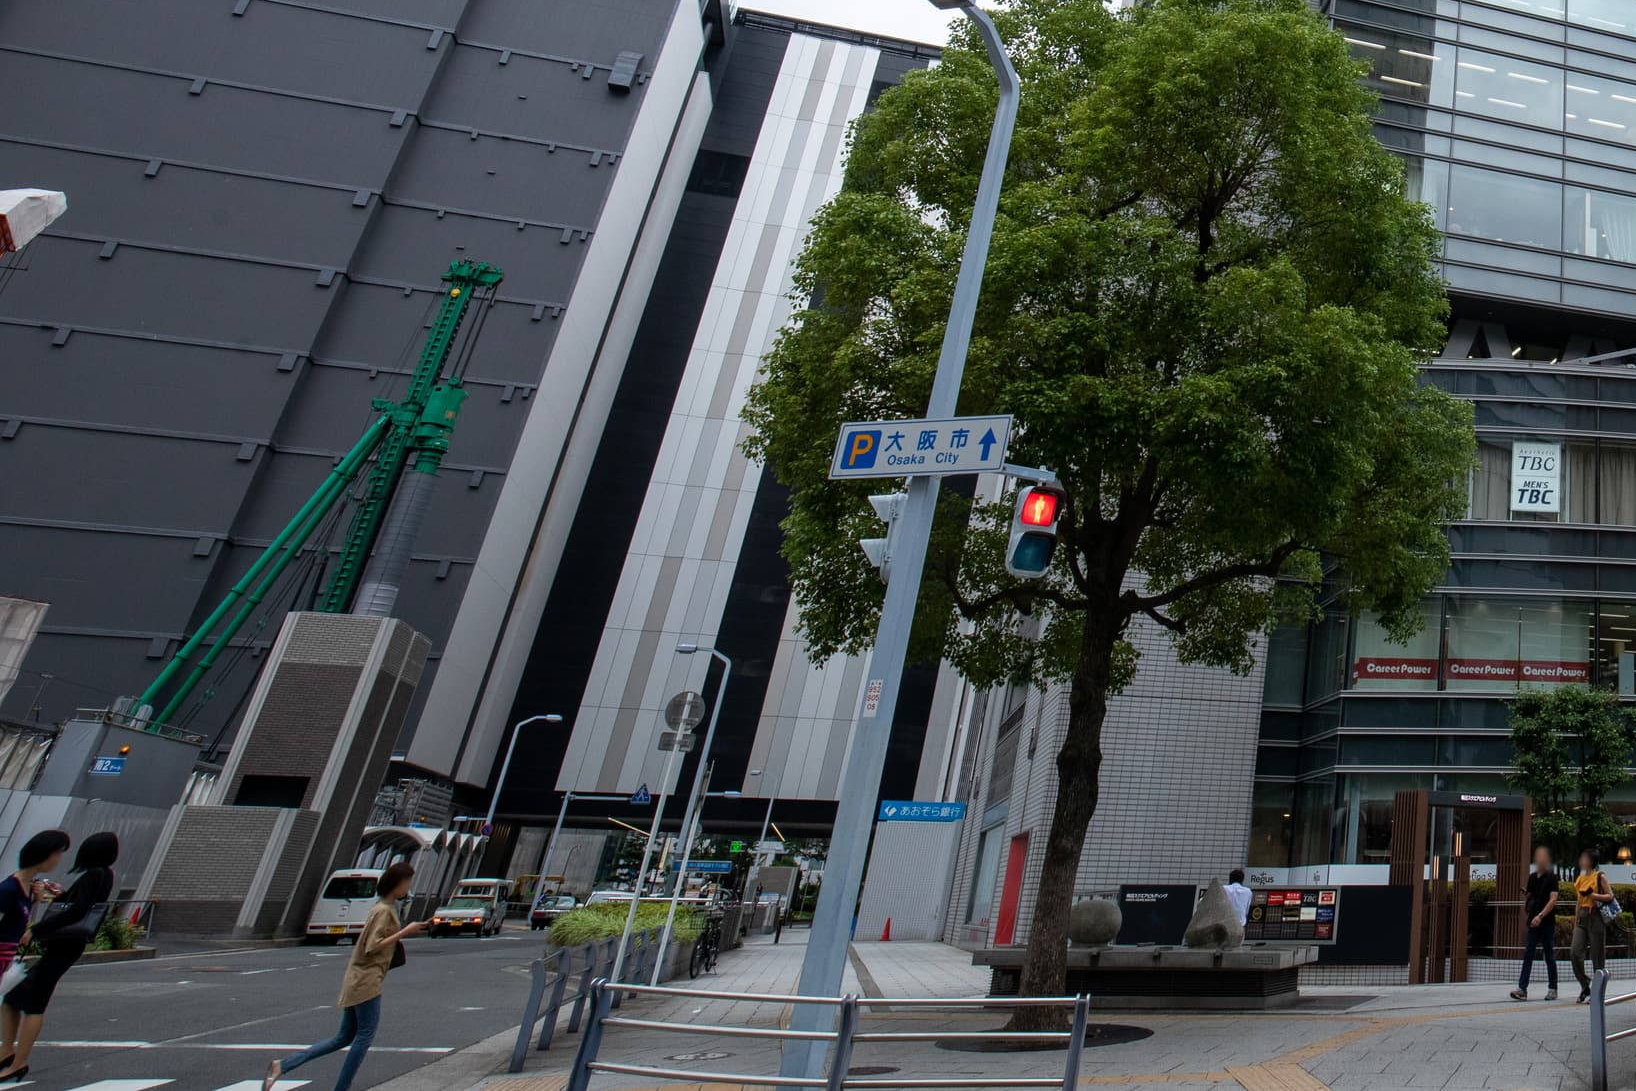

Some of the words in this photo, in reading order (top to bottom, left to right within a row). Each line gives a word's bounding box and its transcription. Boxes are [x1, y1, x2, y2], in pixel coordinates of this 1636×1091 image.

[884, 427, 971, 452] 大阪市
[848, 433, 874, 466] P
[887, 453, 926, 466] Osaka
[935, 451, 960, 464] City
[1518, 455, 1556, 472] TBC
[1522, 480, 1550, 489] MEN'S
[1517, 488, 1554, 505] TBC
[900, 805, 961, 817] あおぞら銀行
[1250, 873, 1274, 886] Regus
